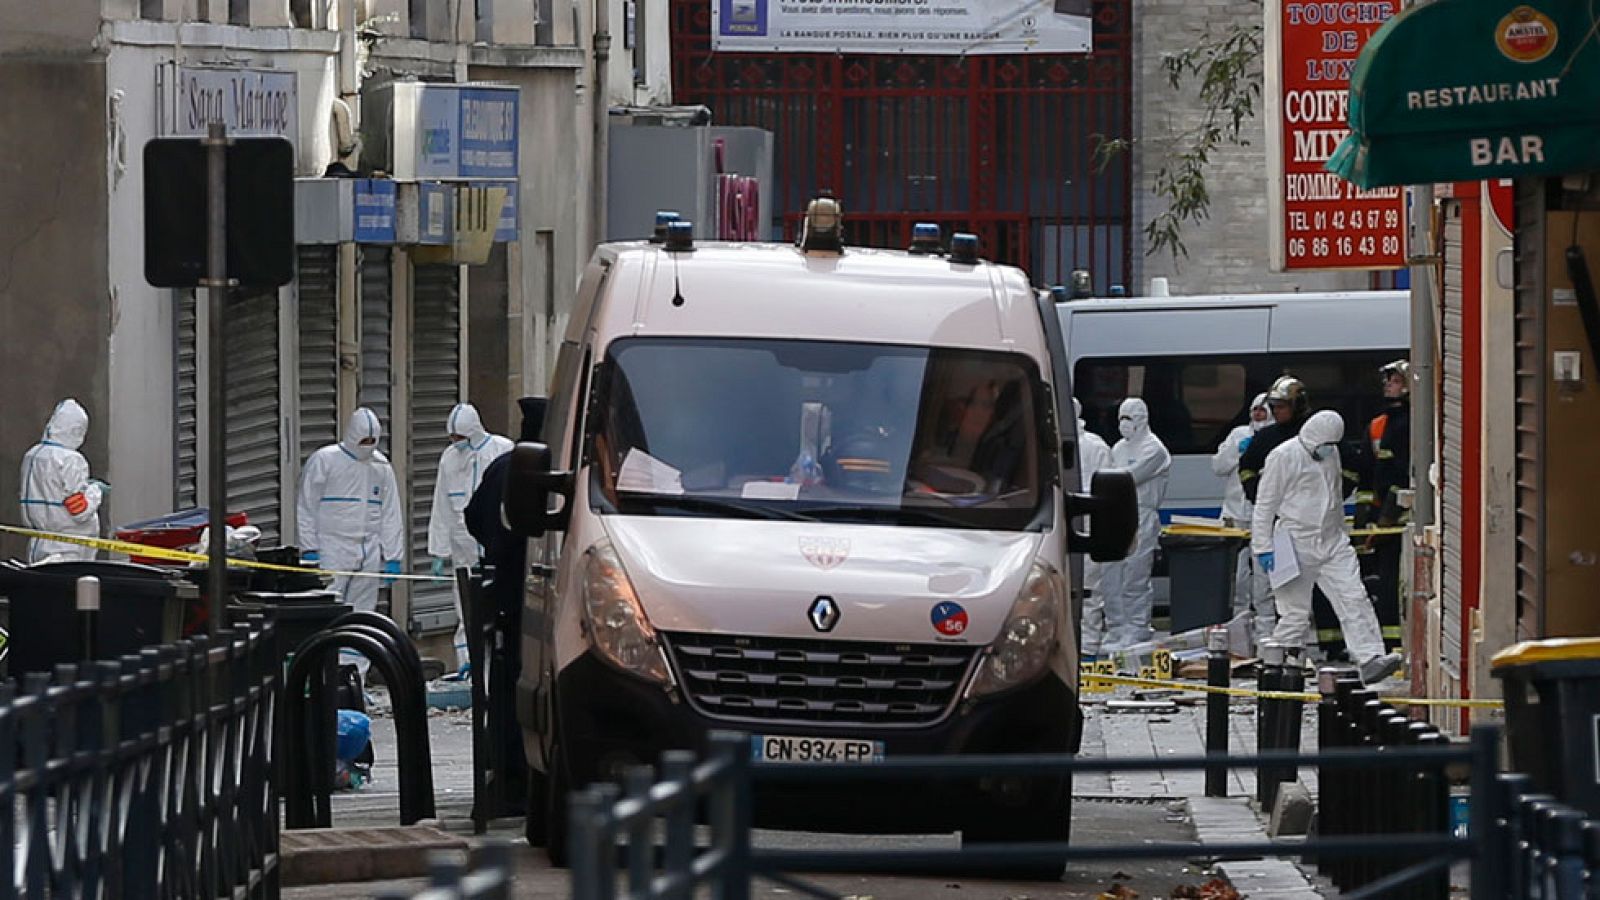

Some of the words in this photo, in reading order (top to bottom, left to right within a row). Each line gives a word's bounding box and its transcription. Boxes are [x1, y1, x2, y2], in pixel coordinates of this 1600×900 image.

[1286, 3, 1393, 25] TOUCHE
[794, 30, 831, 38] BANQUE
[1322, 31, 1359, 52] DE
[1407, 78, 1560, 110] RESTAURANT
[1470, 135, 1545, 166] BAR
[1286, 173, 1342, 201] HOMME
[1288, 211, 1310, 231] TEL
[1314, 211, 1327, 230] 01
[1332, 210, 1345, 230] 42
[1350, 210, 1363, 229] 43
[1367, 209, 1380, 229] 67
[1384, 209, 1398, 229] 99
[1289, 238, 1306, 257] 06
[1312, 237, 1329, 256] 86
[1336, 236, 1352, 256] 16
[1359, 236, 1375, 255] 43
[1382, 236, 1399, 255] 80
[944, 619, 964, 632] 56
